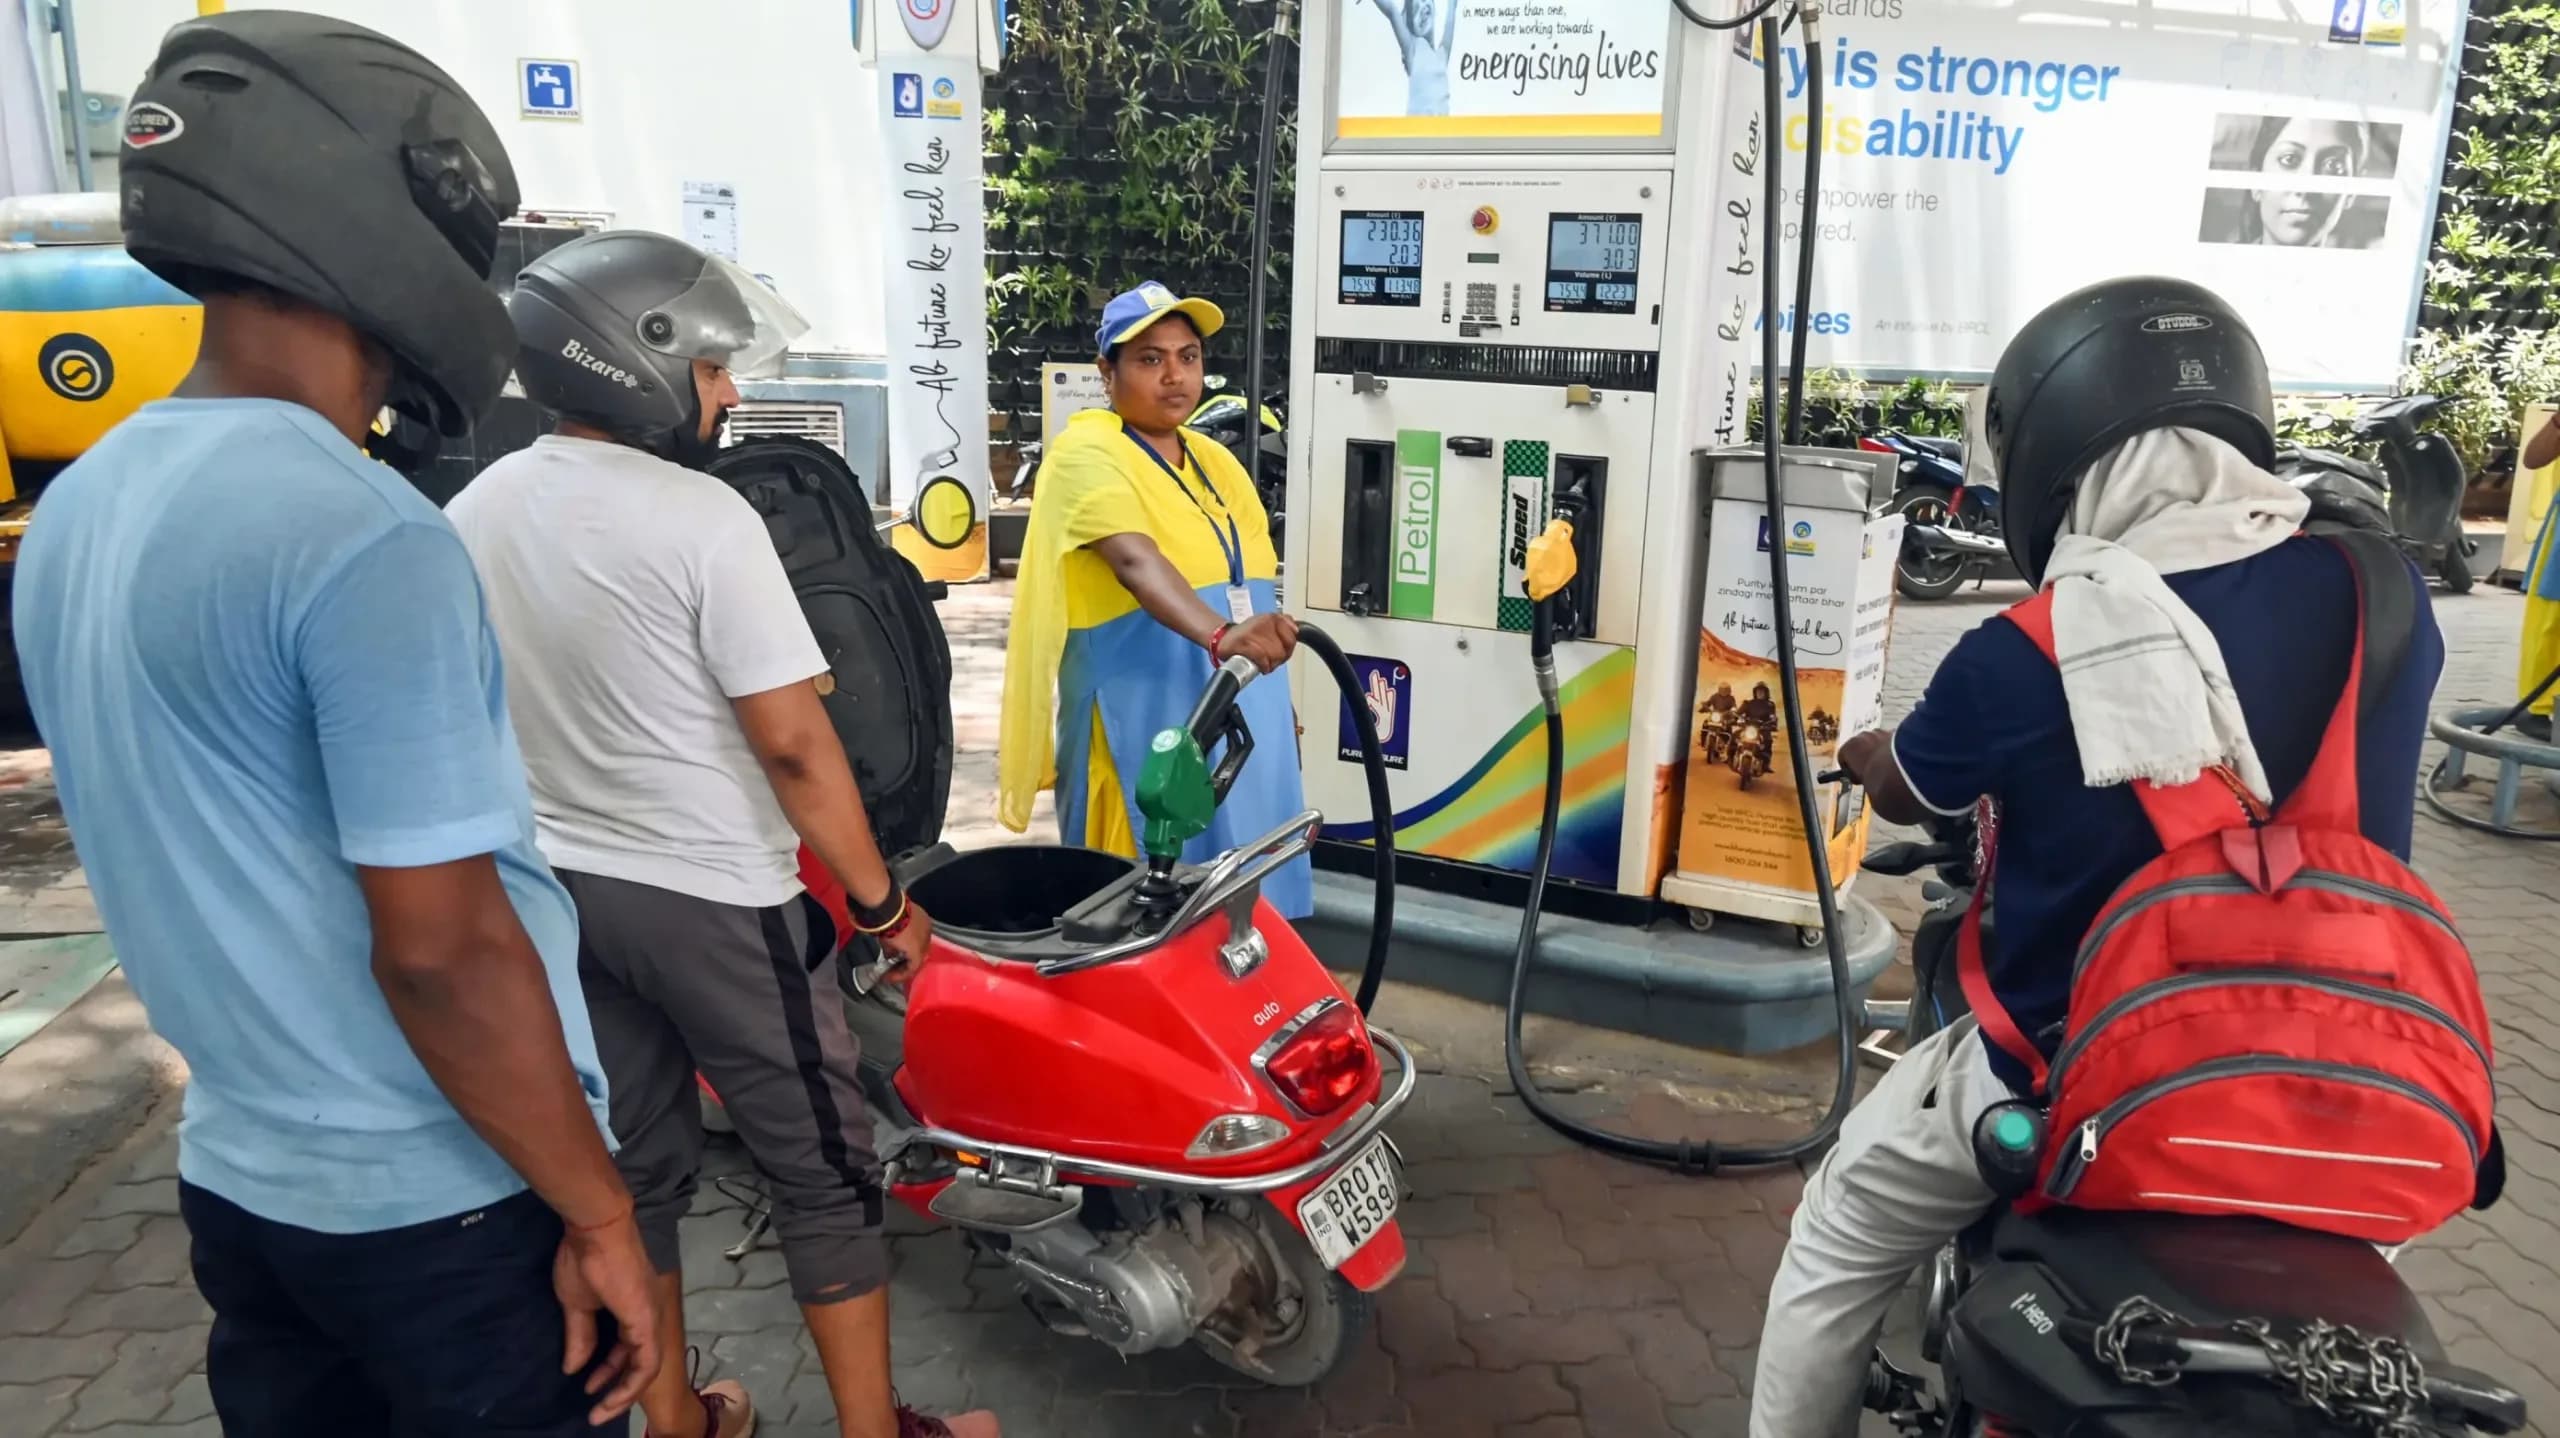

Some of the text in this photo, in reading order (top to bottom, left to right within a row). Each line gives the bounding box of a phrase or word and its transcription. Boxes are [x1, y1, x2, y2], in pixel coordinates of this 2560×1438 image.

[1463, 7, 1472, 18] in
[1474, 6, 1495, 18] more
[1498, 5, 1520, 21] ways
[1524, 1, 1544, 17] than
[1487, 18, 1594, 39] we are working towards
[1460, 30, 1659, 96] energising lives
[1833, 37, 1878, 89] is
[1895, 46, 2120, 113] stronger
[904, 187, 959, 232] feel
[1906, 189, 1939, 211] the
[1389, 244, 1420, 265] 2.03
[1727, 197, 1754, 276] feel
[907, 243, 951, 272] ko
[915, 283, 962, 349] future
[1717, 295, 1747, 342] ko
[562, 339, 626, 382] Bizare
[909, 359, 959, 392] Ab
[1399, 471, 1431, 575] Petrol
[1510, 493, 1528, 570] Speed
[1718, 587, 1753, 599] zindagi
[1821, 597, 1845, 608] bhar
[1737, 577, 1766, 590] Purity
[1810, 586, 1827, 596] par
[1741, 614, 1770, 633] future
